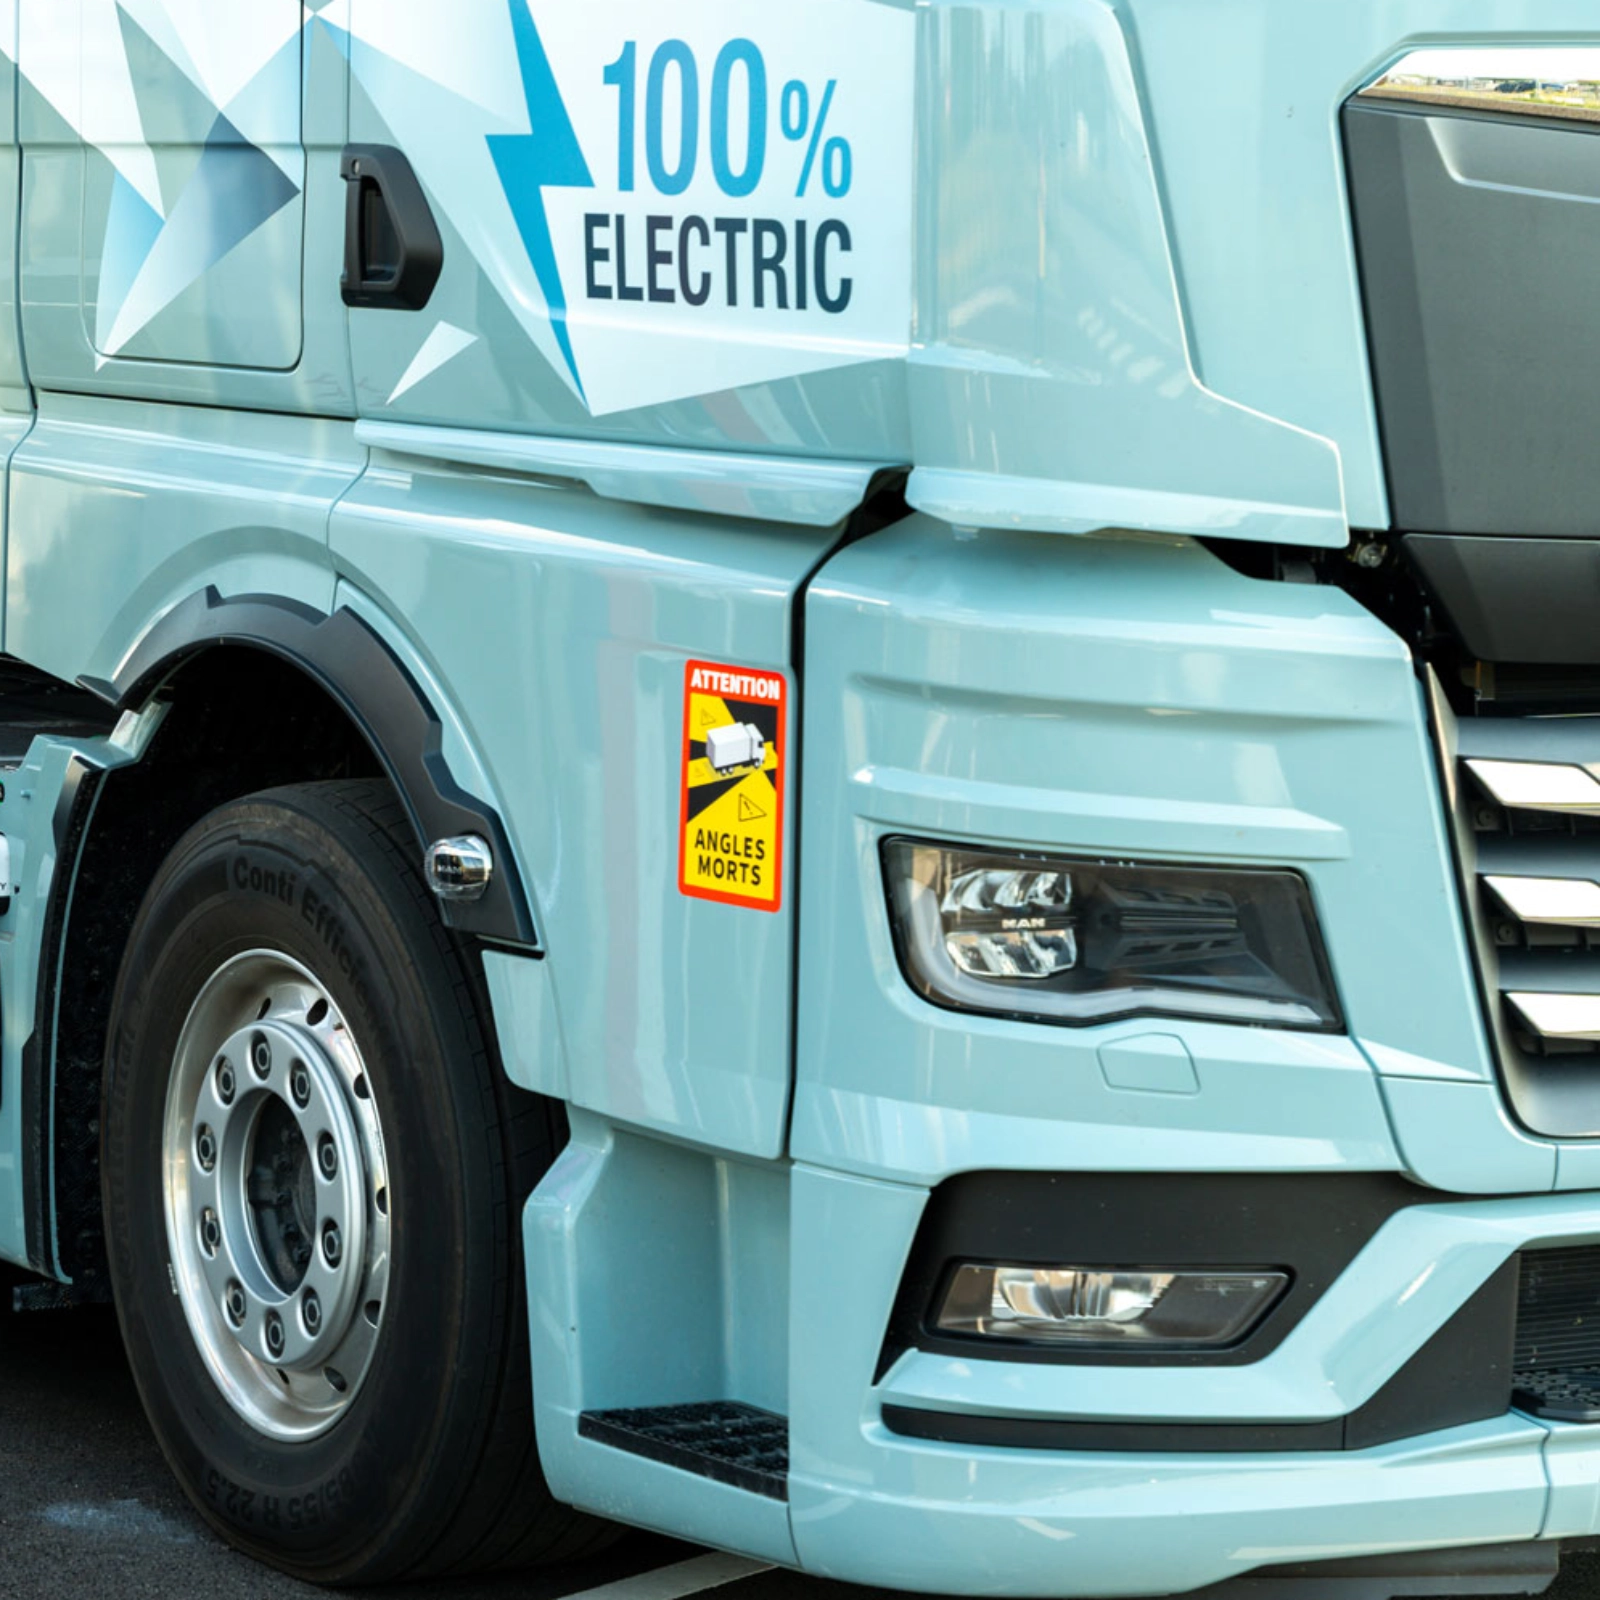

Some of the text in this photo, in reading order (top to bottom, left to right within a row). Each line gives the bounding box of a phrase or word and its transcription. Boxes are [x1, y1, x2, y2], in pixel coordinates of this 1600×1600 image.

[602, 37, 853, 199] 100%
[584, 212, 853, 314] ELECTRIC
[690, 668, 781, 700] ATTENTION
[694, 828, 766, 860] ANGLES
[232, 856, 296, 907] Conti
[697, 855, 761, 886] MORTS
[1001, 917, 1046, 929] MAN
